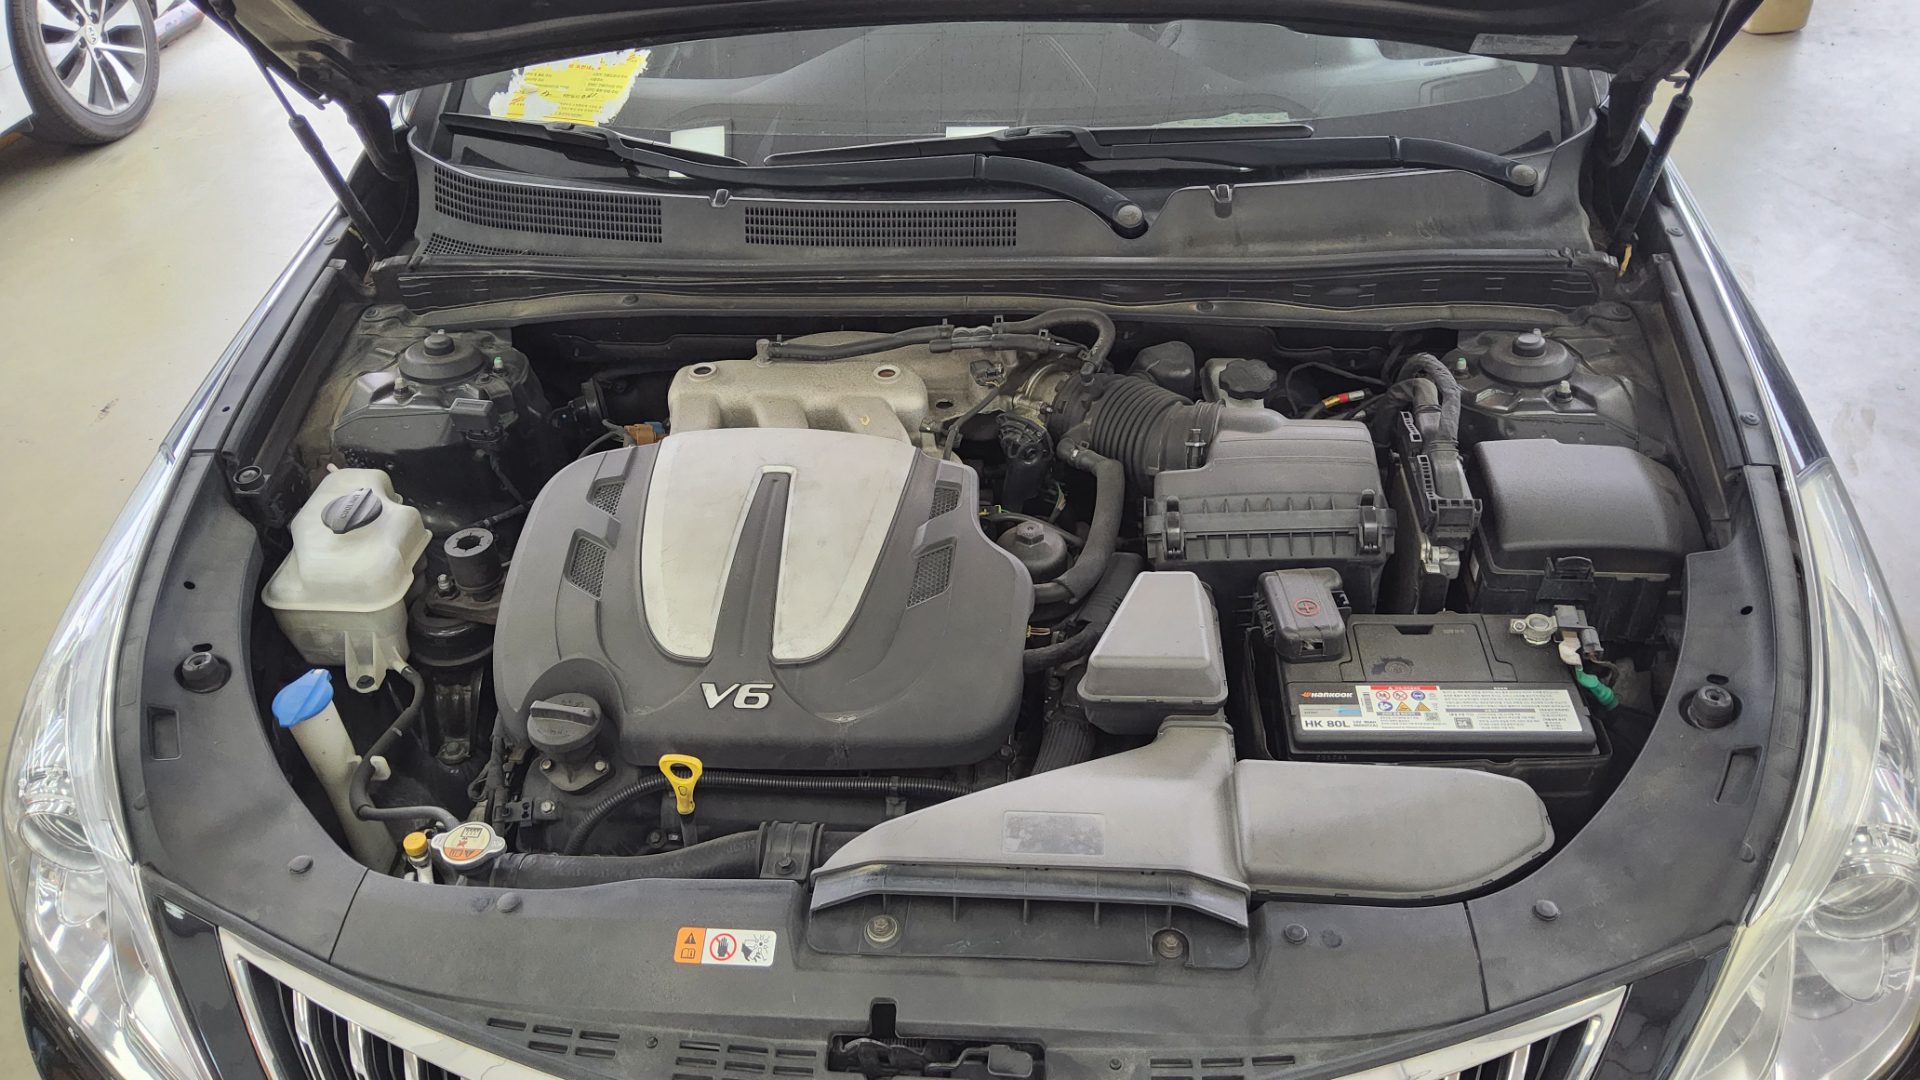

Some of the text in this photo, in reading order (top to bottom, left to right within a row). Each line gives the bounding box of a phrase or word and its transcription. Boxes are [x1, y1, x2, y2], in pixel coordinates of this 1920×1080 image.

[701, 683, 774, 709] V6
[1305, 720, 1323, 728] HK
[1327, 720, 1350, 728] 80L
